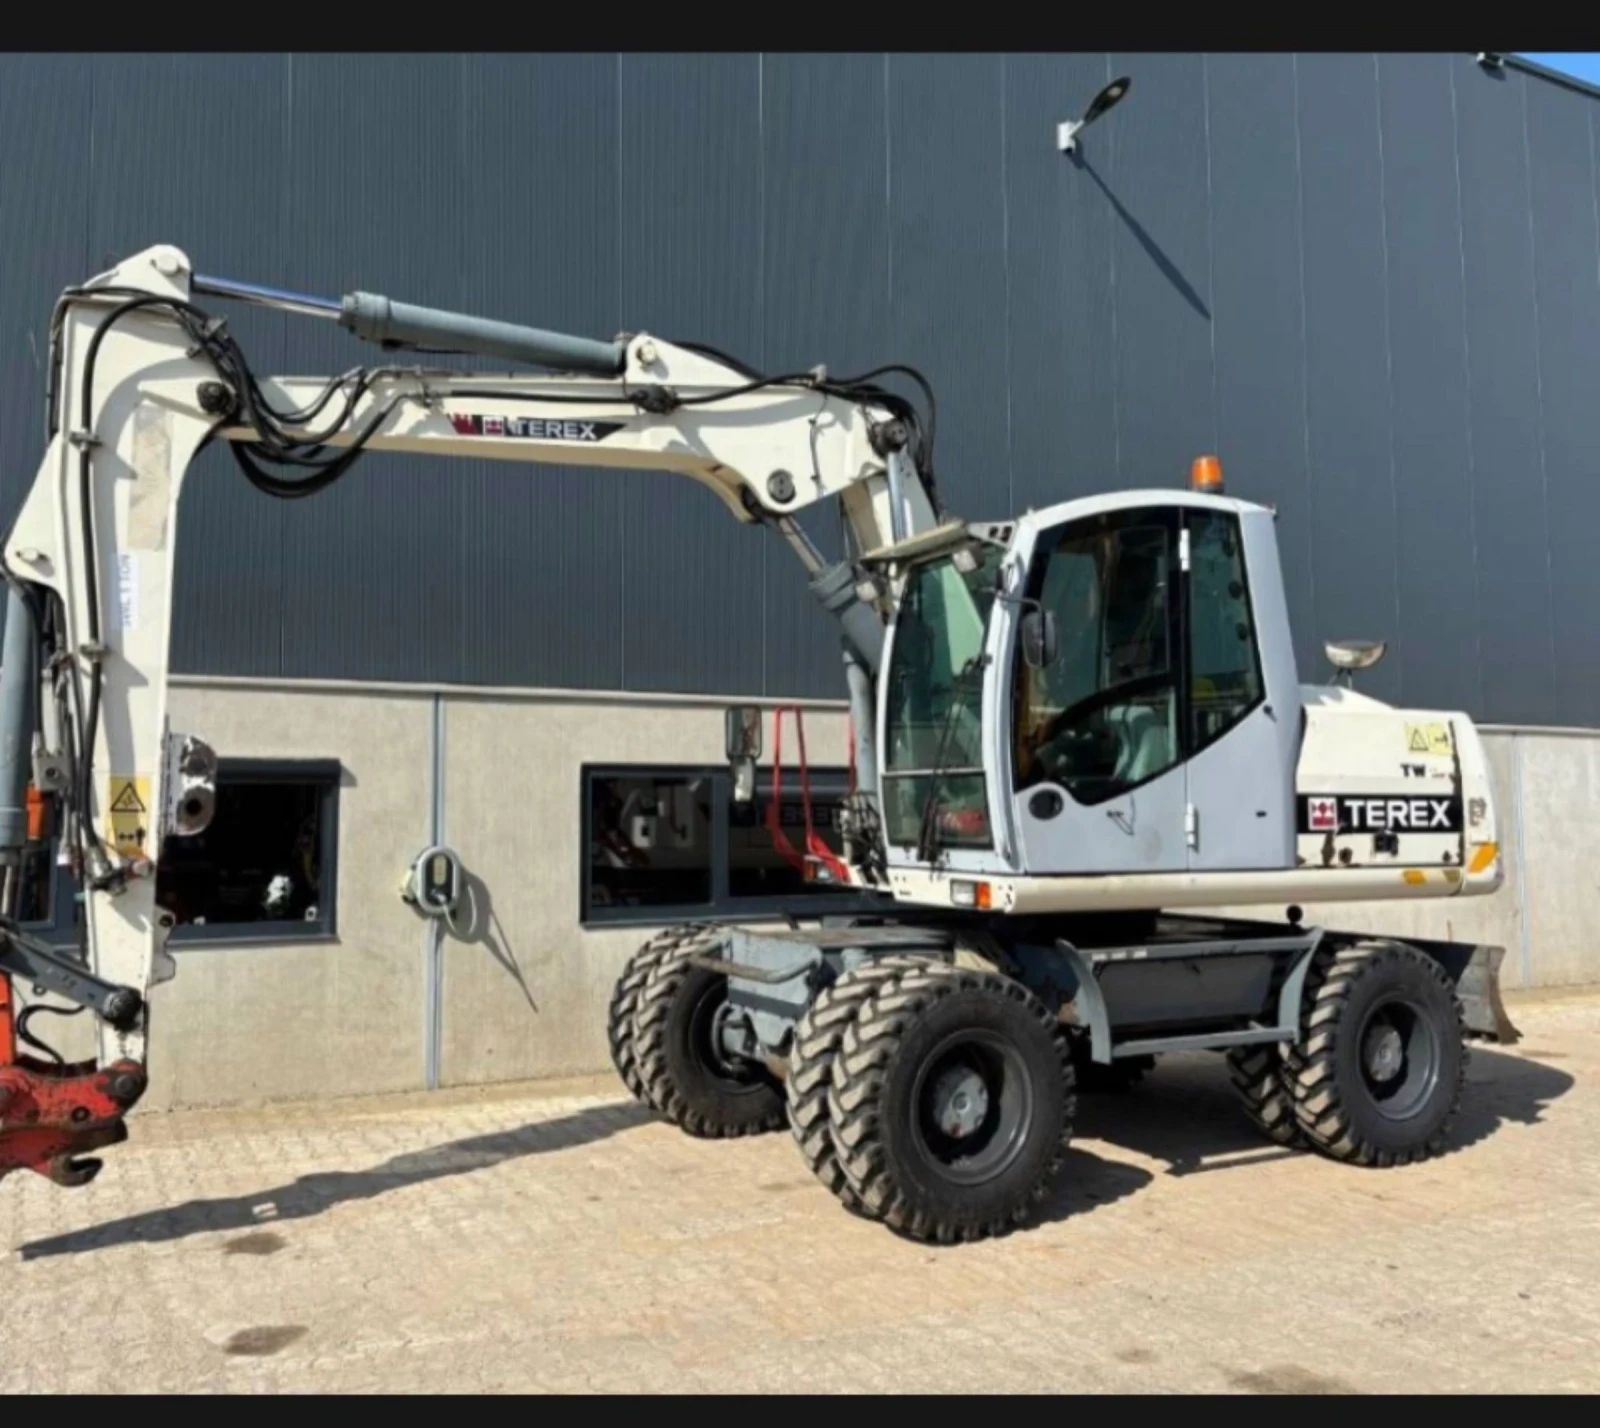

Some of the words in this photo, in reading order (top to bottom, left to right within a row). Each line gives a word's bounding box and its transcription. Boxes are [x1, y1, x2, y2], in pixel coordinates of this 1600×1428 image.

[508, 419, 597, 440] TEREX
[1400, 763, 1425, 778] TW
[1343, 799, 1451, 828] TEREX
